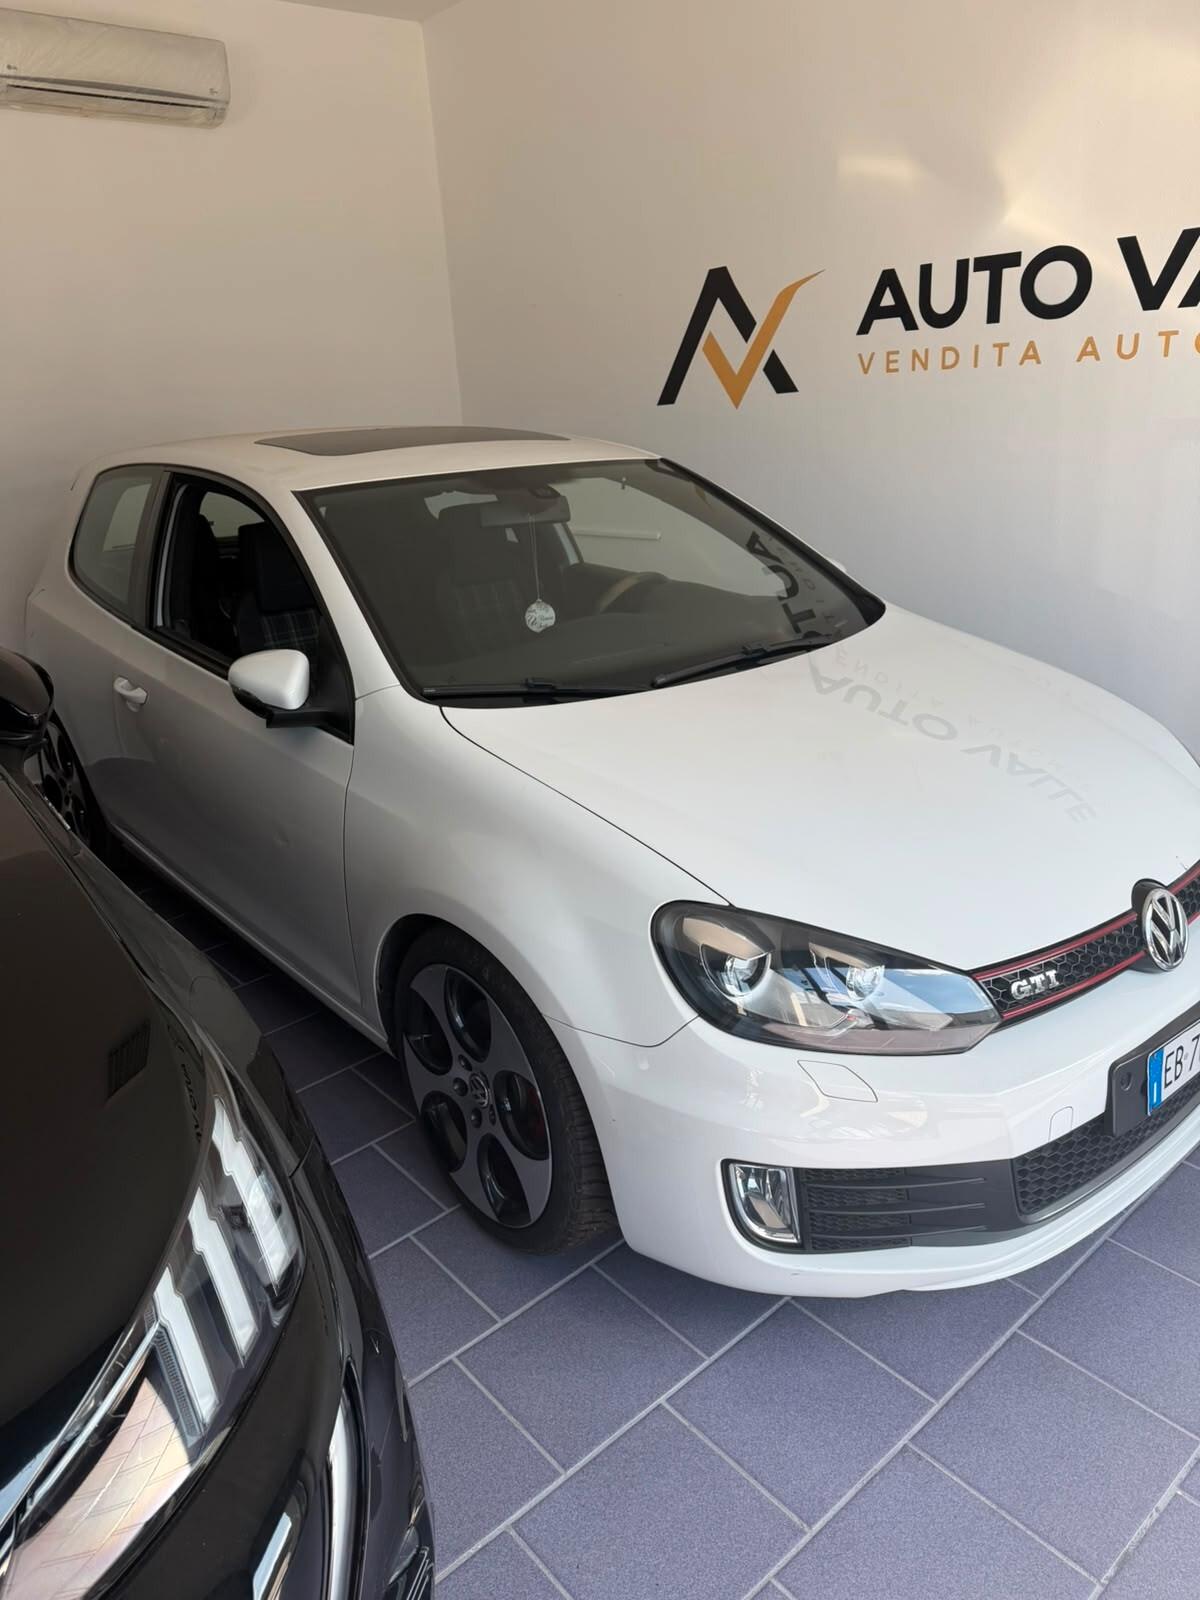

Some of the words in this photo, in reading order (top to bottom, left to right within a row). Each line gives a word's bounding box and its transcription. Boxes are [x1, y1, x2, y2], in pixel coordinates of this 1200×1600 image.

[855, 244, 1093, 336] AUTO
[857, 339, 1042, 375] VENDITA
[1076, 329, 1200, 363] AUT
[1010, 969, 1061, 1000] GTI
[1164, 1044, 1184, 1089] EB
